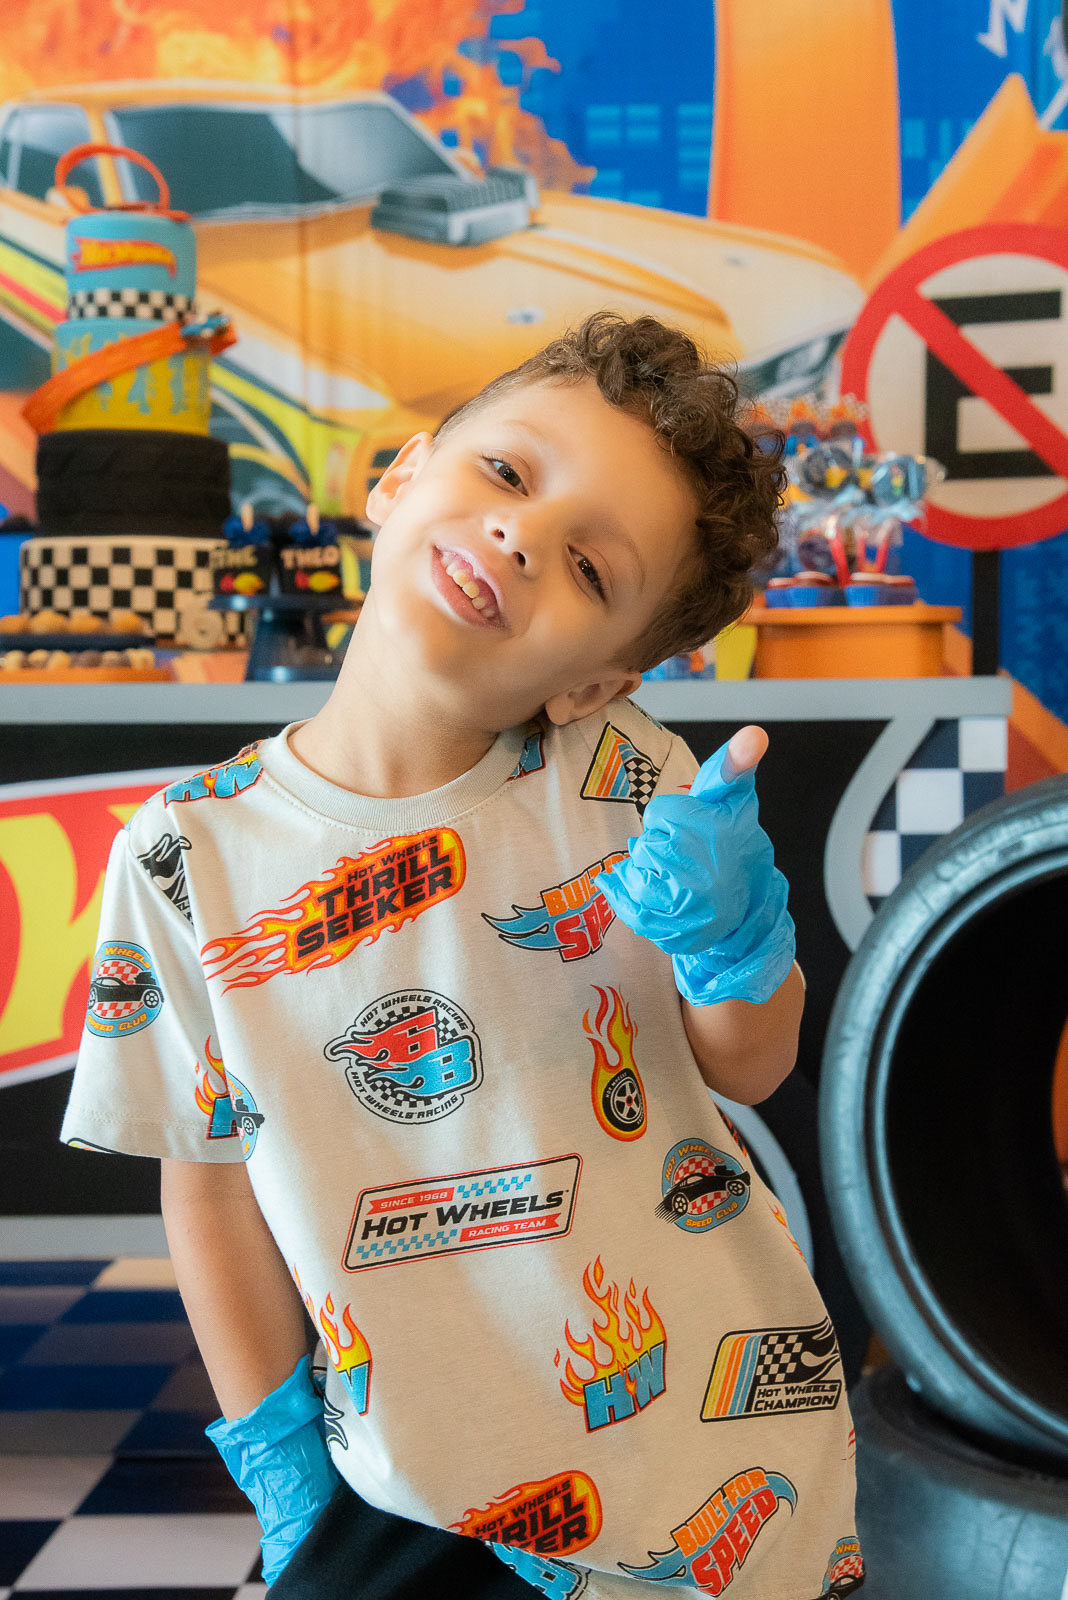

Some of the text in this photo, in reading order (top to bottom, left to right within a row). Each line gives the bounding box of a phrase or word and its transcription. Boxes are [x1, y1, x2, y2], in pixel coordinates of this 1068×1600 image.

[926, 291, 1064, 479] E
[317, 846, 451, 918] THRILL
[347, 836, 438, 884] HOT WHEELS
[296, 866, 453, 959] SEEKER
[555, 892, 617, 960] SPE
[104, 946, 152, 969] WHEELS
[118, 1013, 148, 1031] CLUB
[359, 994, 468, 1031] HOT WHEELS RACING
[350, 1071, 459, 1120] HOT WHEELS RACING
[664, 1155, 677, 1182] HOT
[361, 1190, 565, 1240] HOT WHEELS
[380, 1191, 448, 1209] SINCE 1968
[685, 1216, 713, 1228] SPEED
[468, 1219, 547, 1238] RACING TEAM
[582, 1339, 667, 1433] HW
[754, 1395, 836, 1412] CHAMPION
[757, 1384, 839, 1399] HOT WHEELS
[475, 1514, 507, 1536] HOT
[512, 1479, 572, 1518] WHEELS
[488, 1491, 585, 1545] RILL
[671, 1468, 770, 1558] BUILT FOR
[690, 1488, 779, 1597] SPEED
